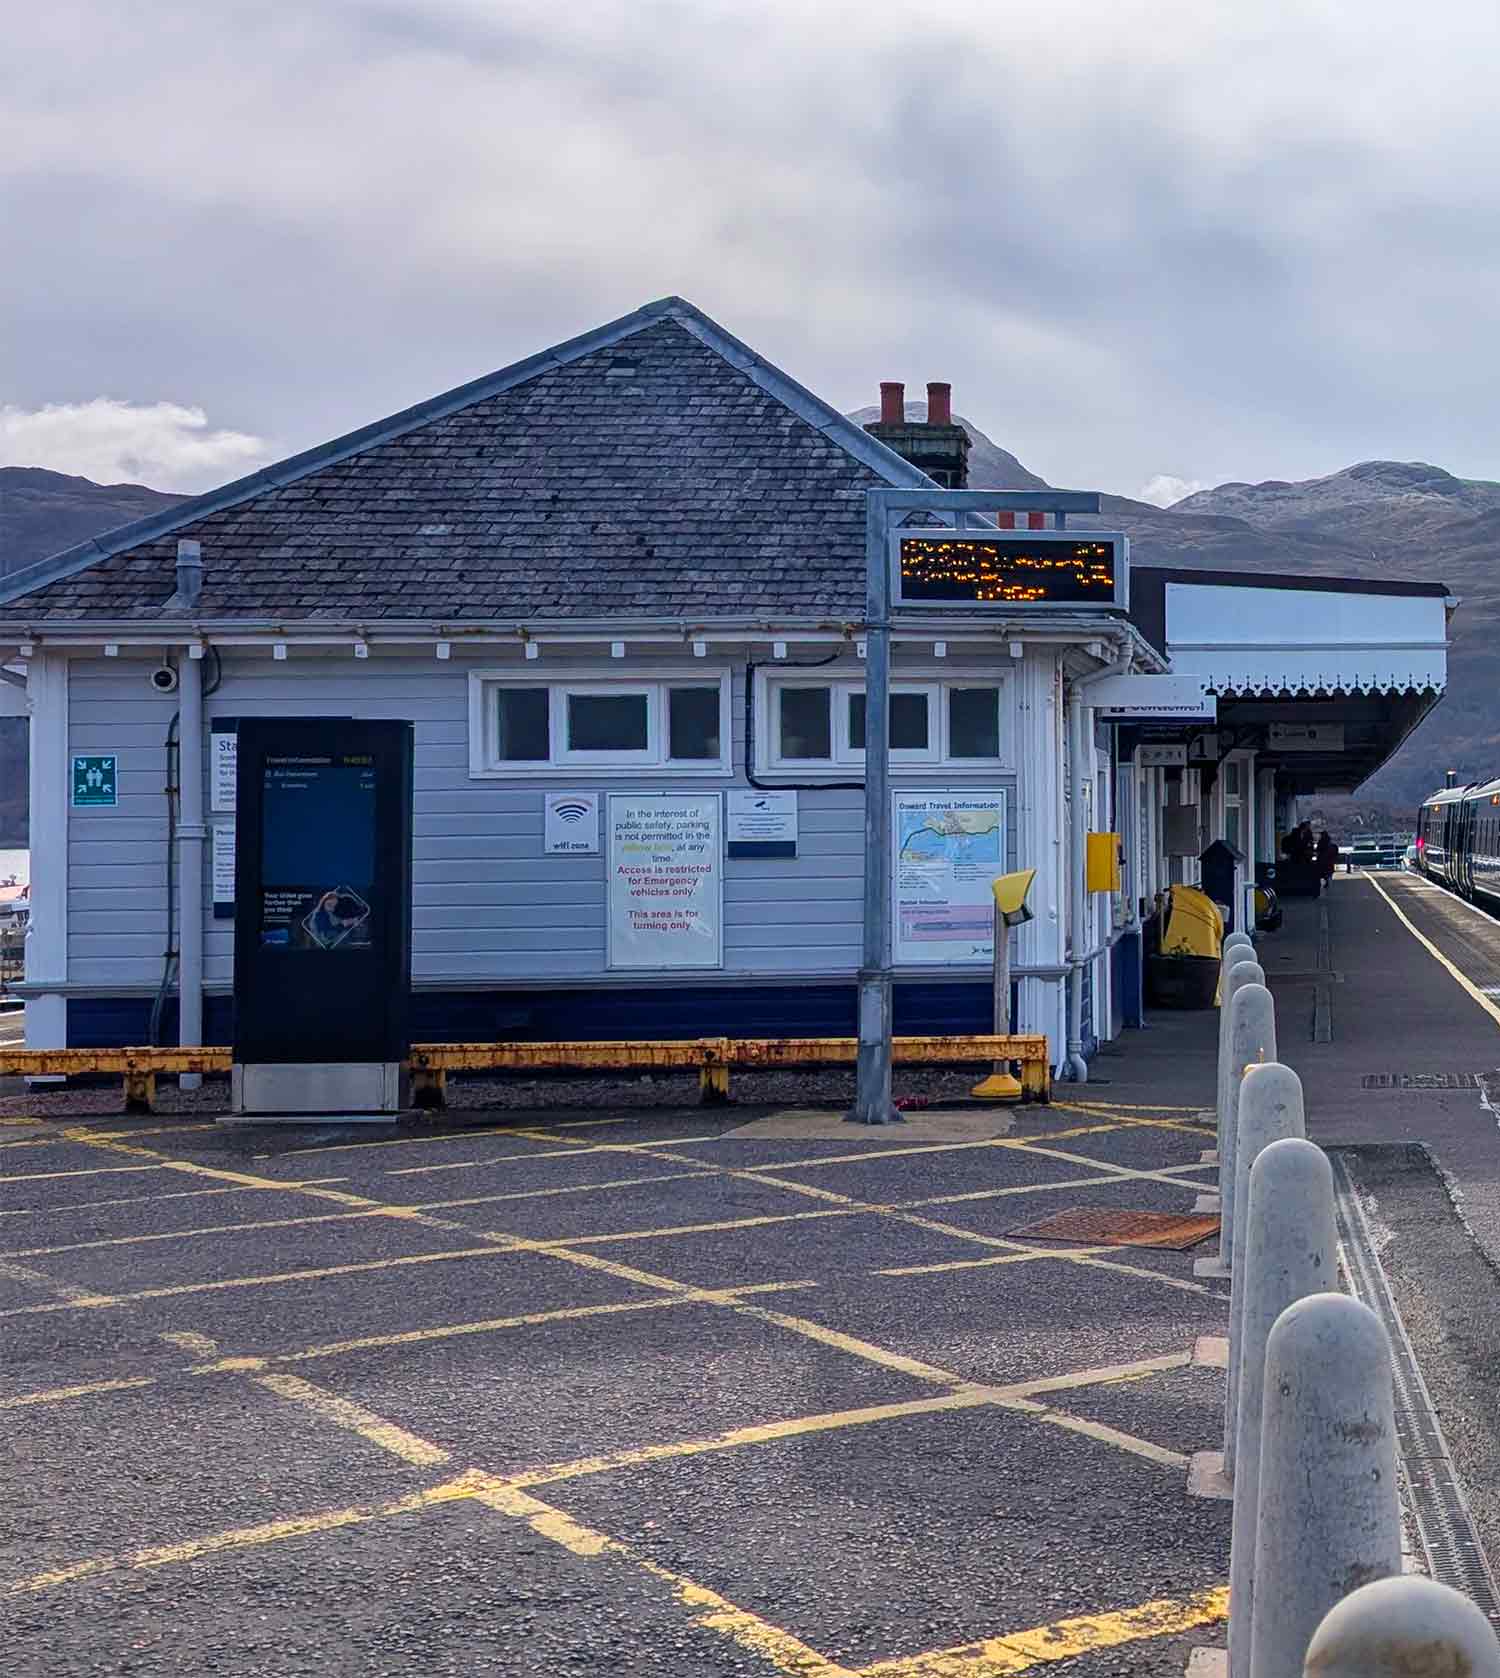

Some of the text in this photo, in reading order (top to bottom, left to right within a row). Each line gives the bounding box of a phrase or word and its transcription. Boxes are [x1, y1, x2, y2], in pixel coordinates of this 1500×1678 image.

[929, 802, 952, 810] Travel
[953, 801, 999, 809] Information
[626, 808, 699, 818] In the interest of
[616, 821, 710, 831] public safety, parking
[615, 832, 710, 842] is not permitted in the
[554, 841, 589, 850] wifi zone
[677, 844, 686, 852] at
[688, 844, 705, 854] any
[652, 854, 673, 863] time.
[617, 864, 712, 874] Access is restricted
[628, 876, 698, 887] for Emergency
[630, 887, 696, 898] vehicles only.
[628, 910, 648, 918] This
[674, 910, 682, 918] is
[685, 910, 699, 918] for
[633, 921, 693, 931] turning only.
